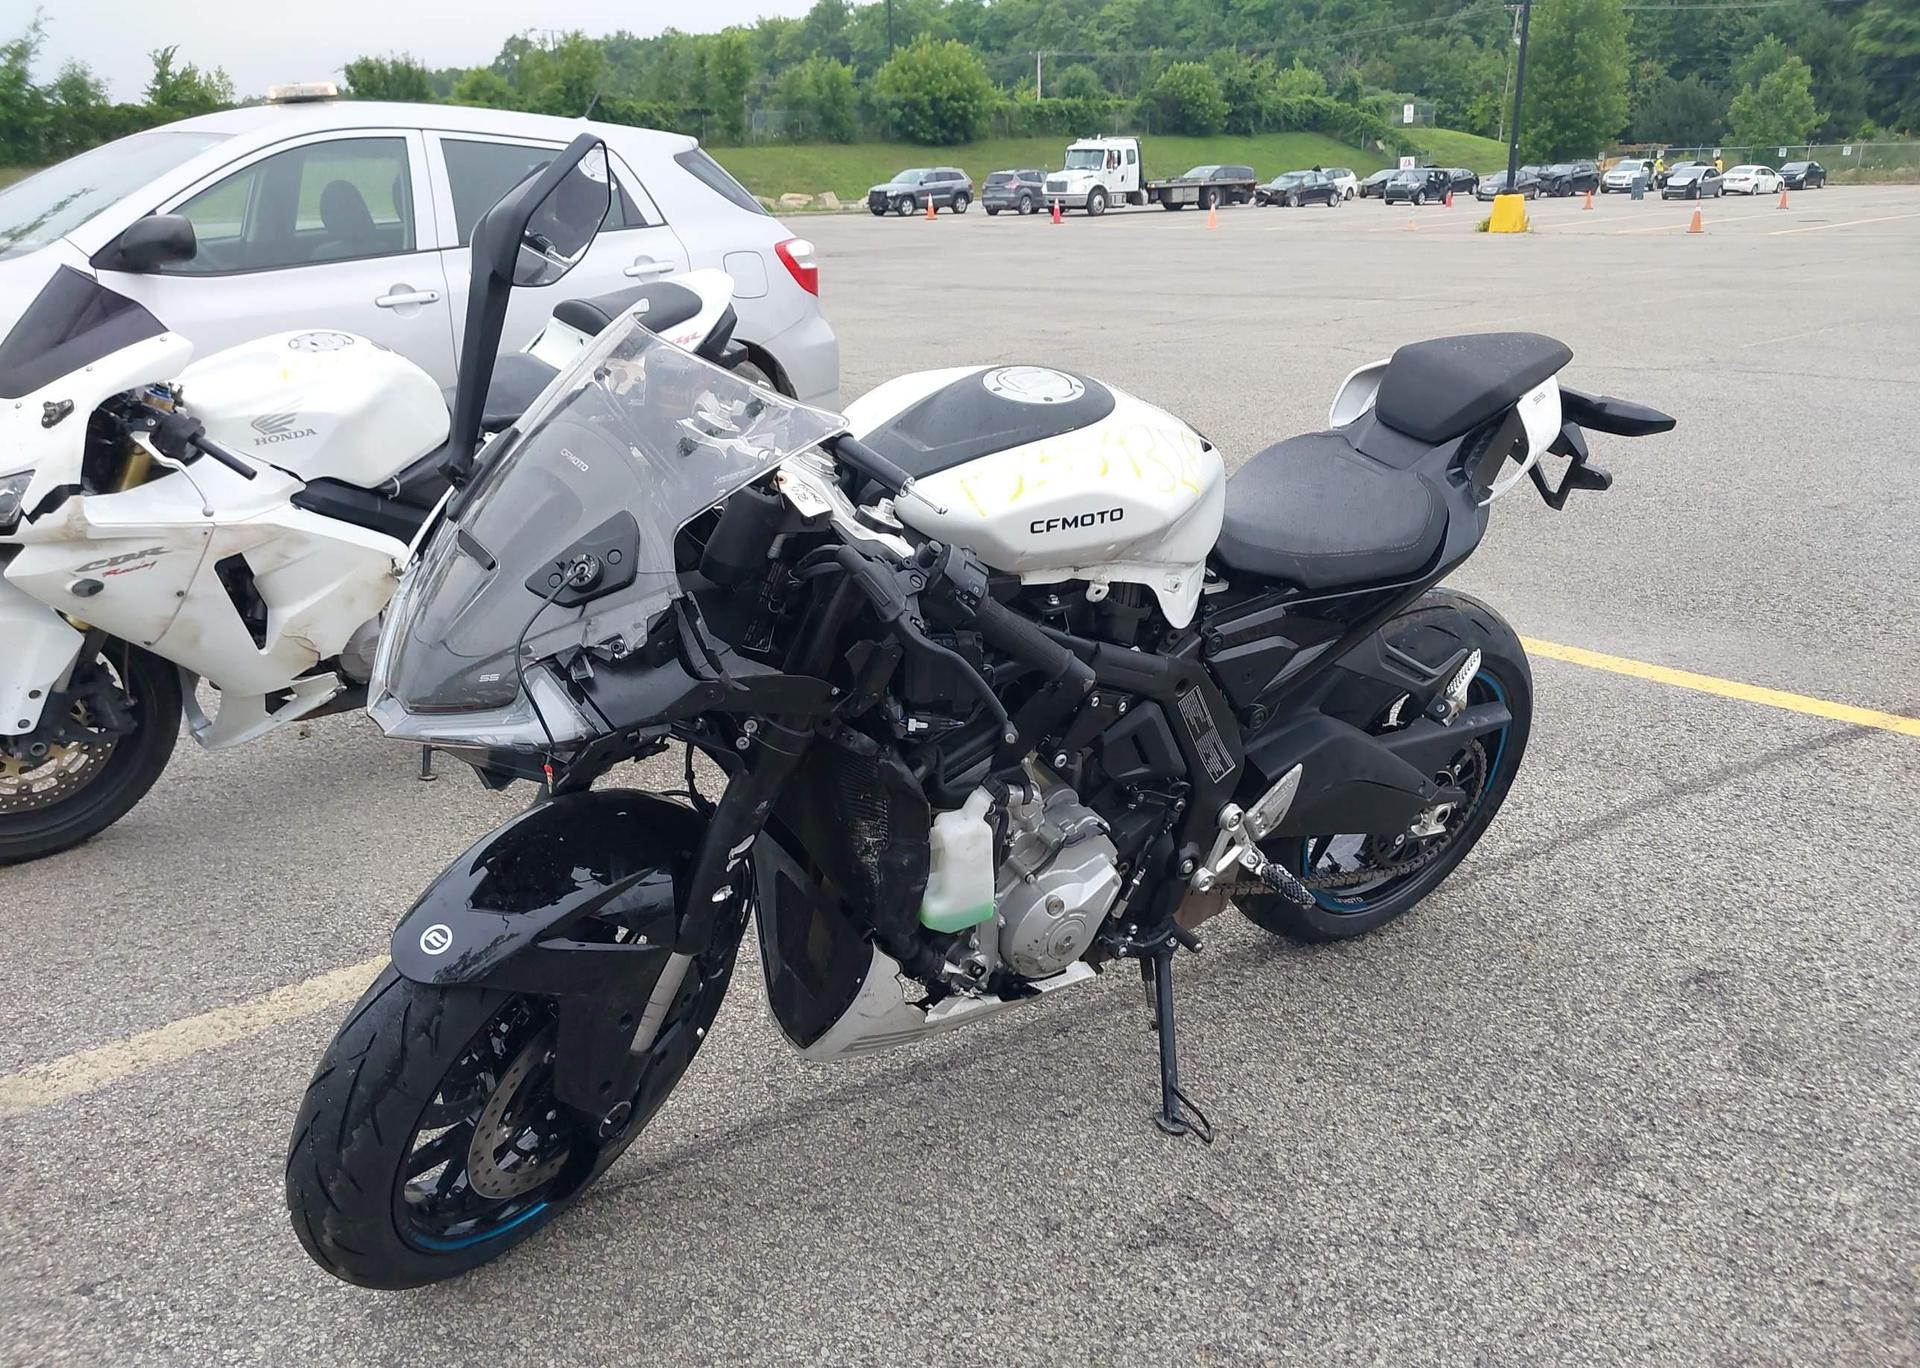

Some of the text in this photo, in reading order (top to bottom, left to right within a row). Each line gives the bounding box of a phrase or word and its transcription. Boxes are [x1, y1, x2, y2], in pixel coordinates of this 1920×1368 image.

[253, 428, 318, 446] HONDA
[1029, 507, 1124, 534] CFMOTO
[73, 546, 174, 573] CBR
